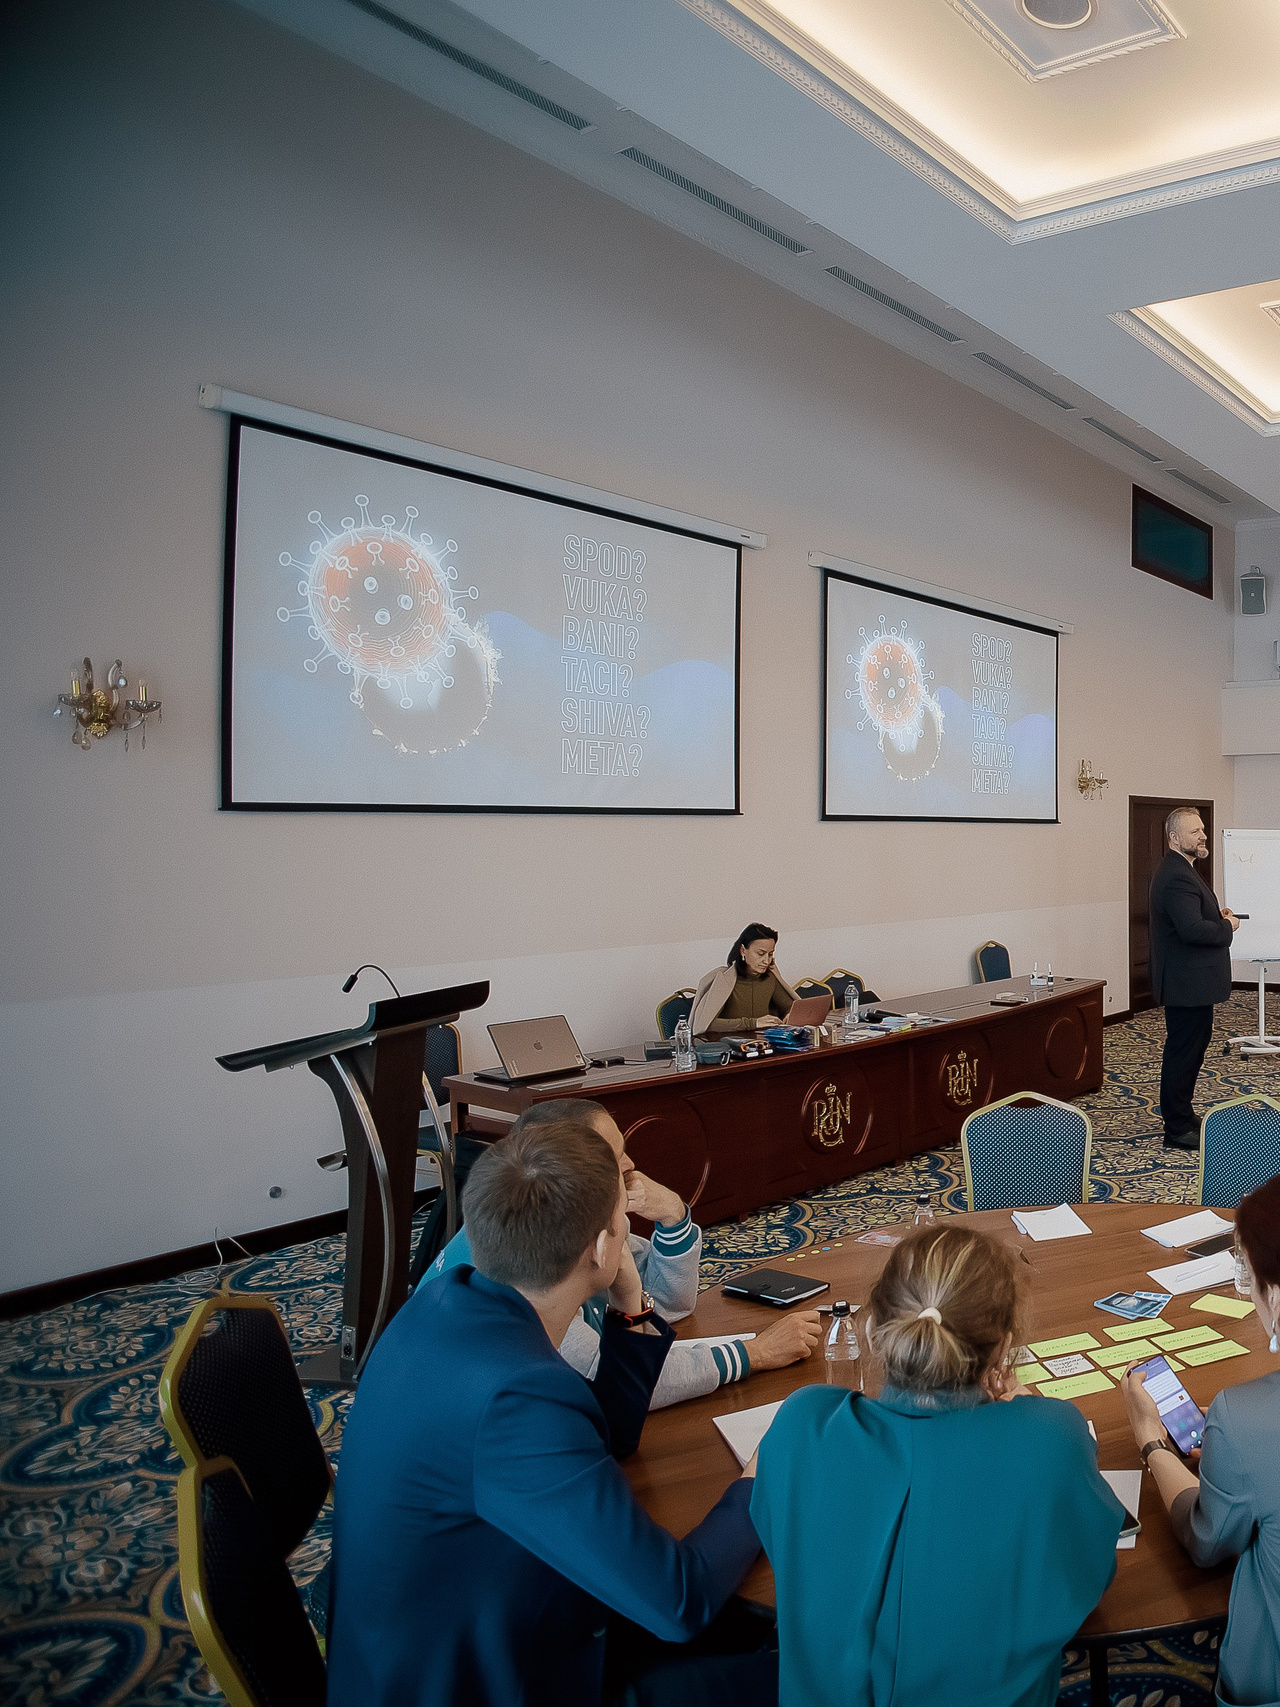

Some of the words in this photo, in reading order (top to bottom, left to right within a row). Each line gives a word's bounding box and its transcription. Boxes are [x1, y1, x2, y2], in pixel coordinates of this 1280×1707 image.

[563, 534, 647, 583] SPOD?
[563, 574, 648, 622] VUKA?
[562, 615, 639, 660] BANI?
[972, 632, 1012, 663] SPOD?
[561, 656, 633, 698] TACI?
[972, 660, 1012, 689] VUKA?
[561, 698, 651, 738] SHIVA?
[972, 687, 1010, 715] BANI?
[972, 714, 1007, 741] TACI?
[562, 738, 643, 776] META?
[972, 742, 1014, 768] SHIVA?
[972, 769, 1010, 794] META?
